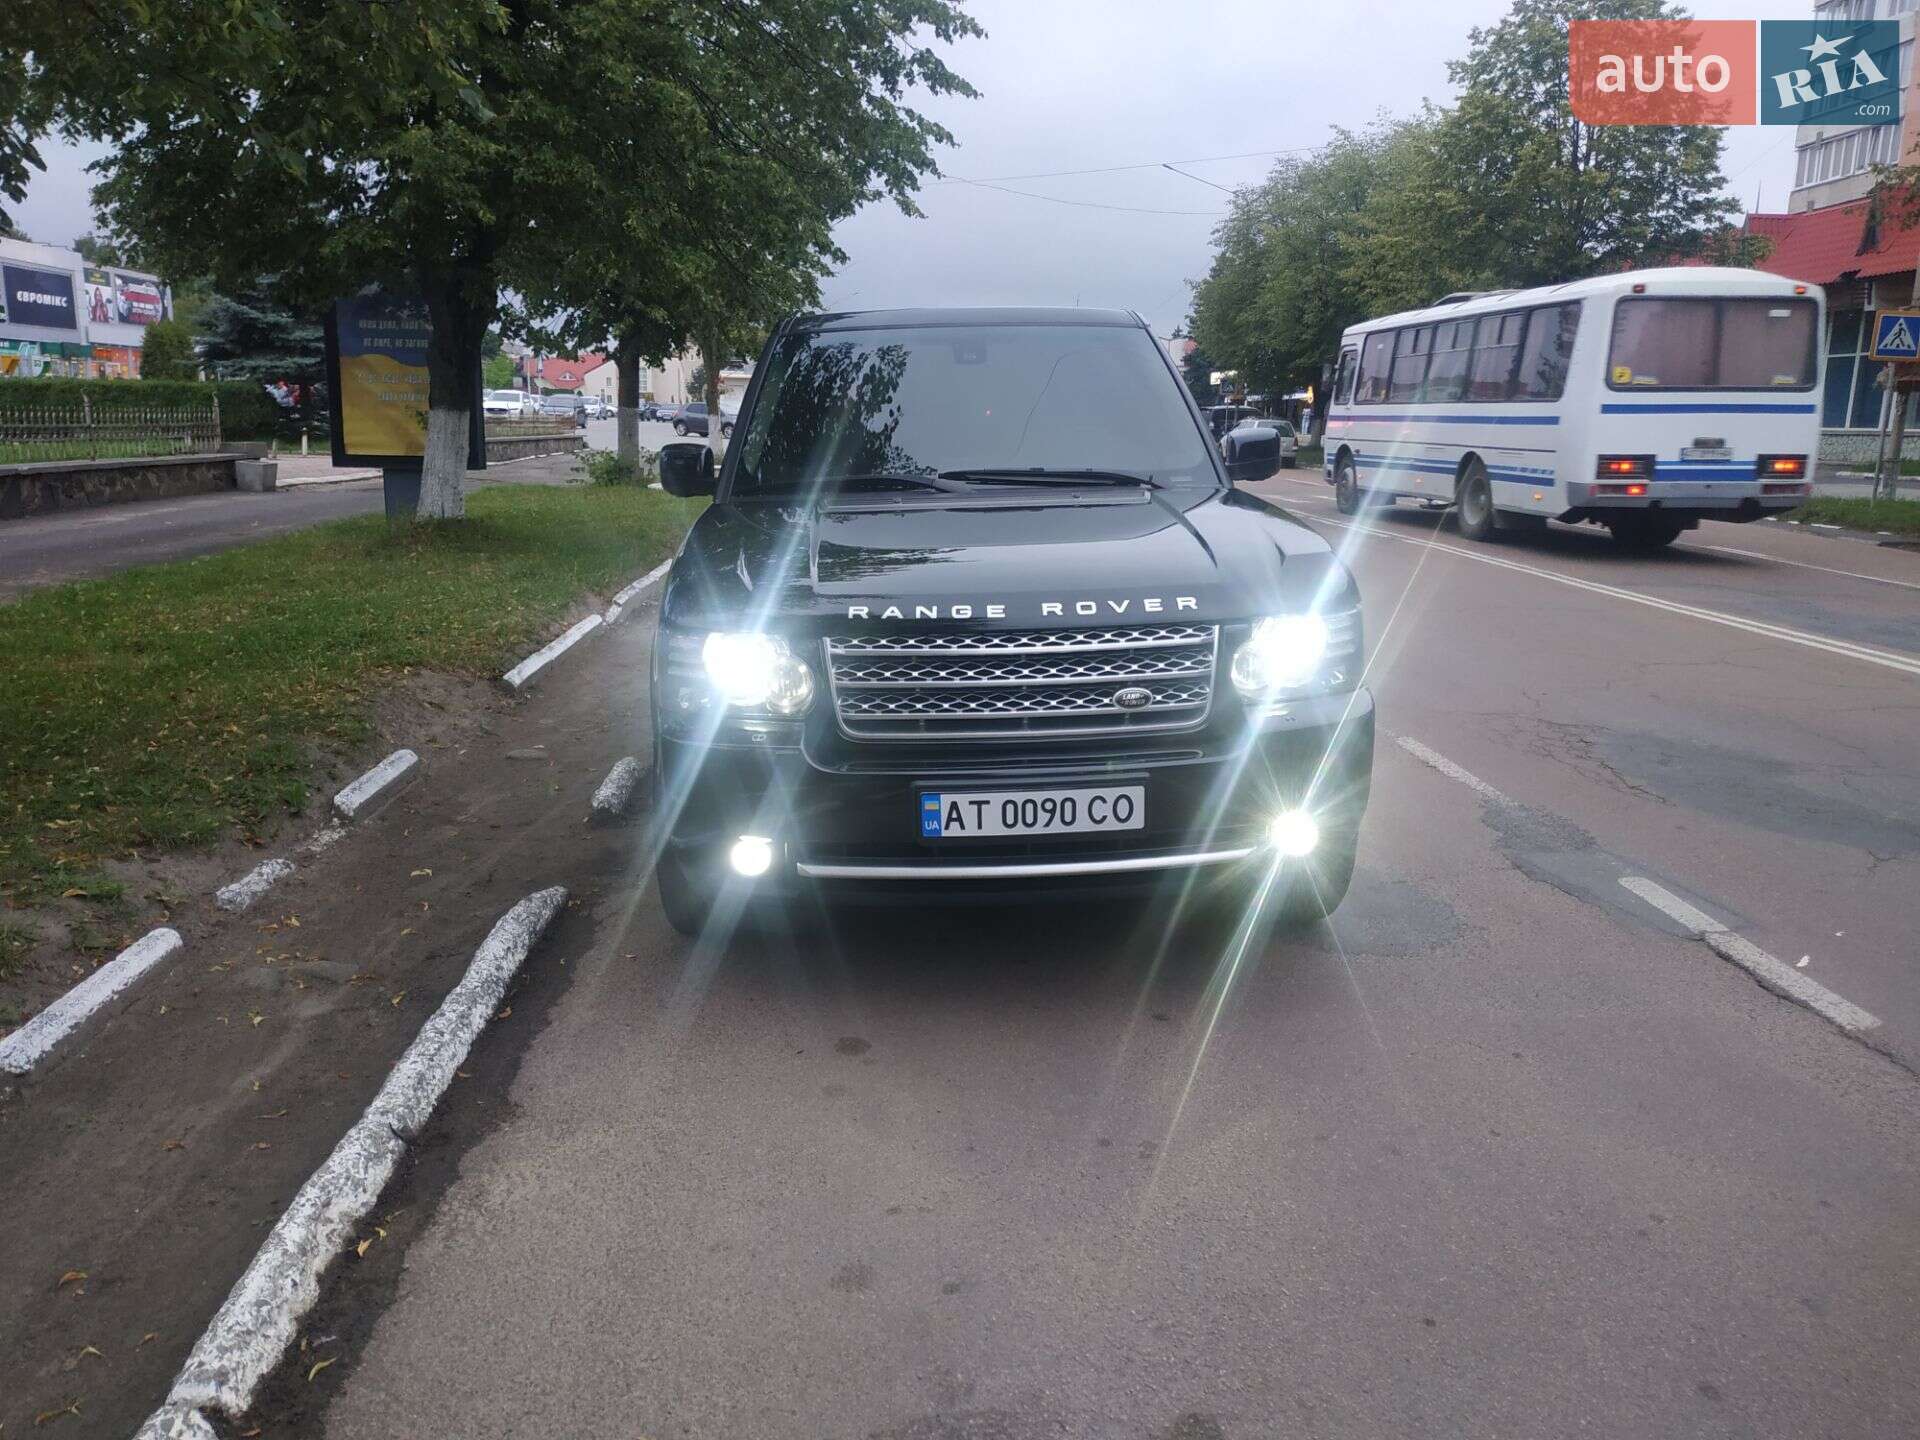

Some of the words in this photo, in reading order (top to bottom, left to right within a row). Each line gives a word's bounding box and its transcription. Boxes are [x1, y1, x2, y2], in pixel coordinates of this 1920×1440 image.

[848, 604, 1006, 619] RANGE
[1041, 596, 1199, 616] ROVER
[944, 800, 990, 831] AT
[1001, 797, 1077, 829] 0090
[1087, 793, 1134, 825] CO
[924, 821, 940, 831] UA
